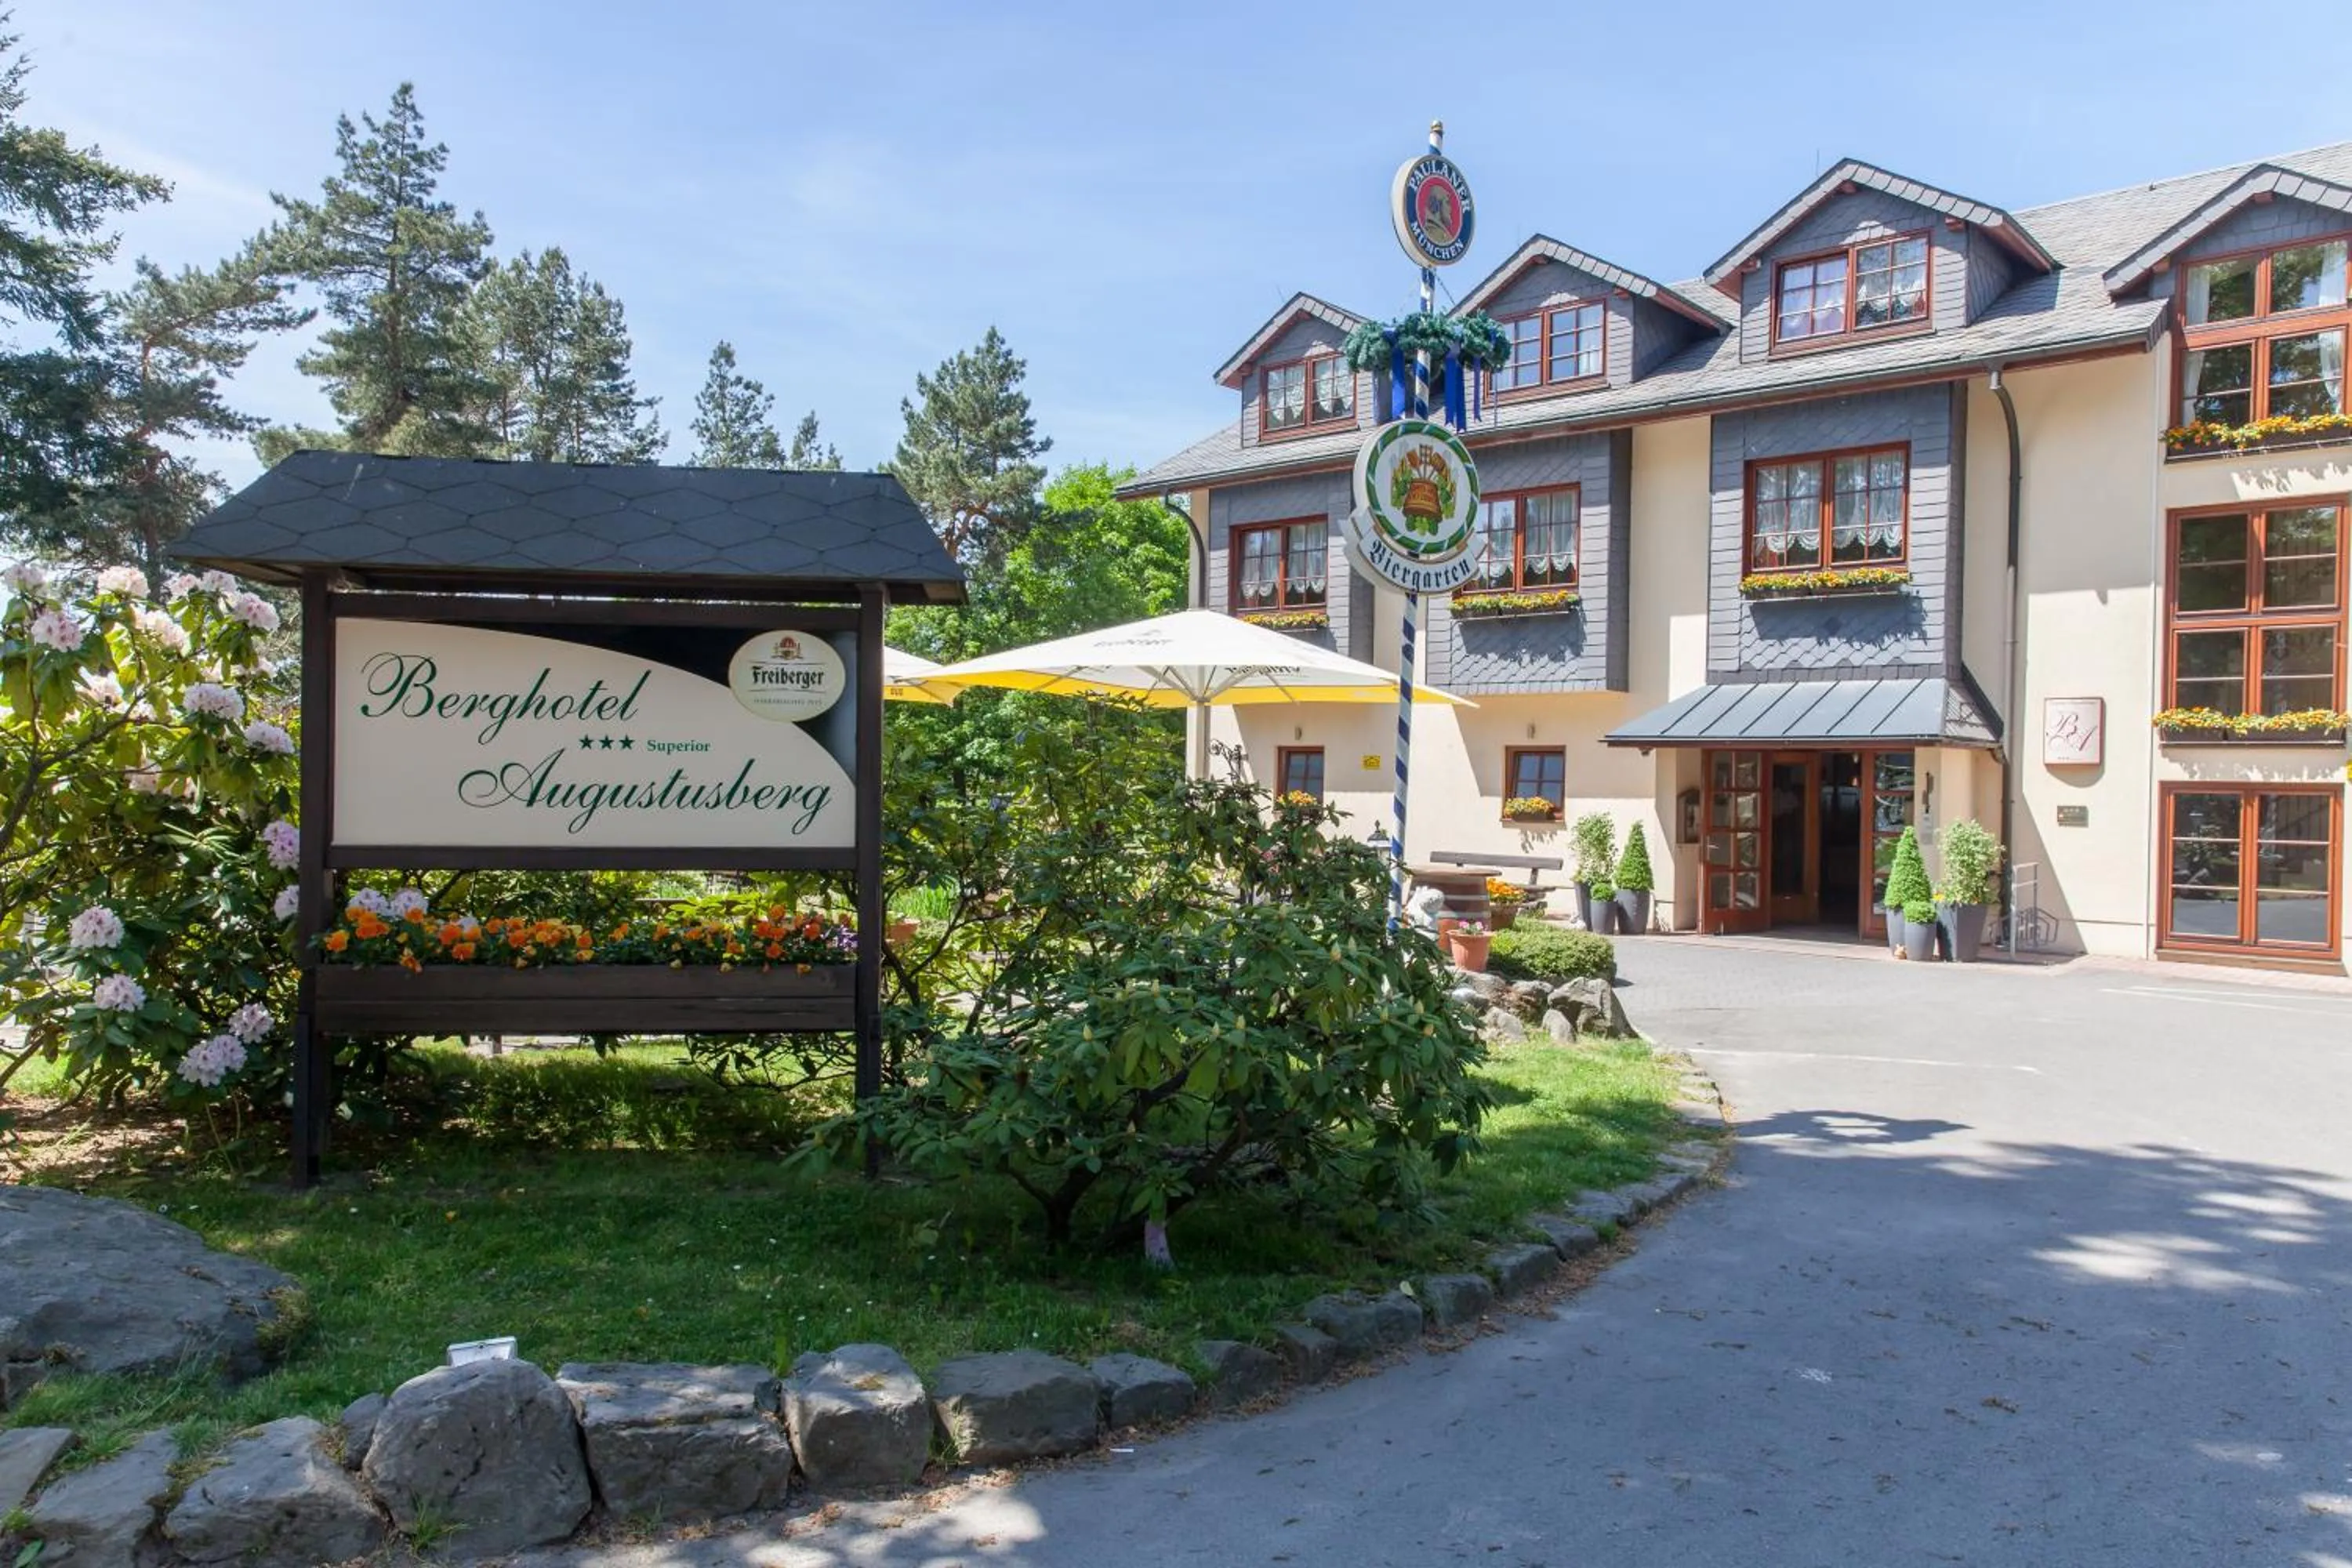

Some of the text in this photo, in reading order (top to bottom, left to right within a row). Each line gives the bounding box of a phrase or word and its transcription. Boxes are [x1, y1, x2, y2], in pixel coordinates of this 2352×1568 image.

[1409, 160, 1471, 213] PAULANER
[1369, 539, 1471, 592] Biergarten
[361, 652, 652, 746] Berghotel
[751, 666, 825, 689] Freiberger
[647, 739, 710, 755] Superior
[458, 746, 832, 835] Augustusberg
